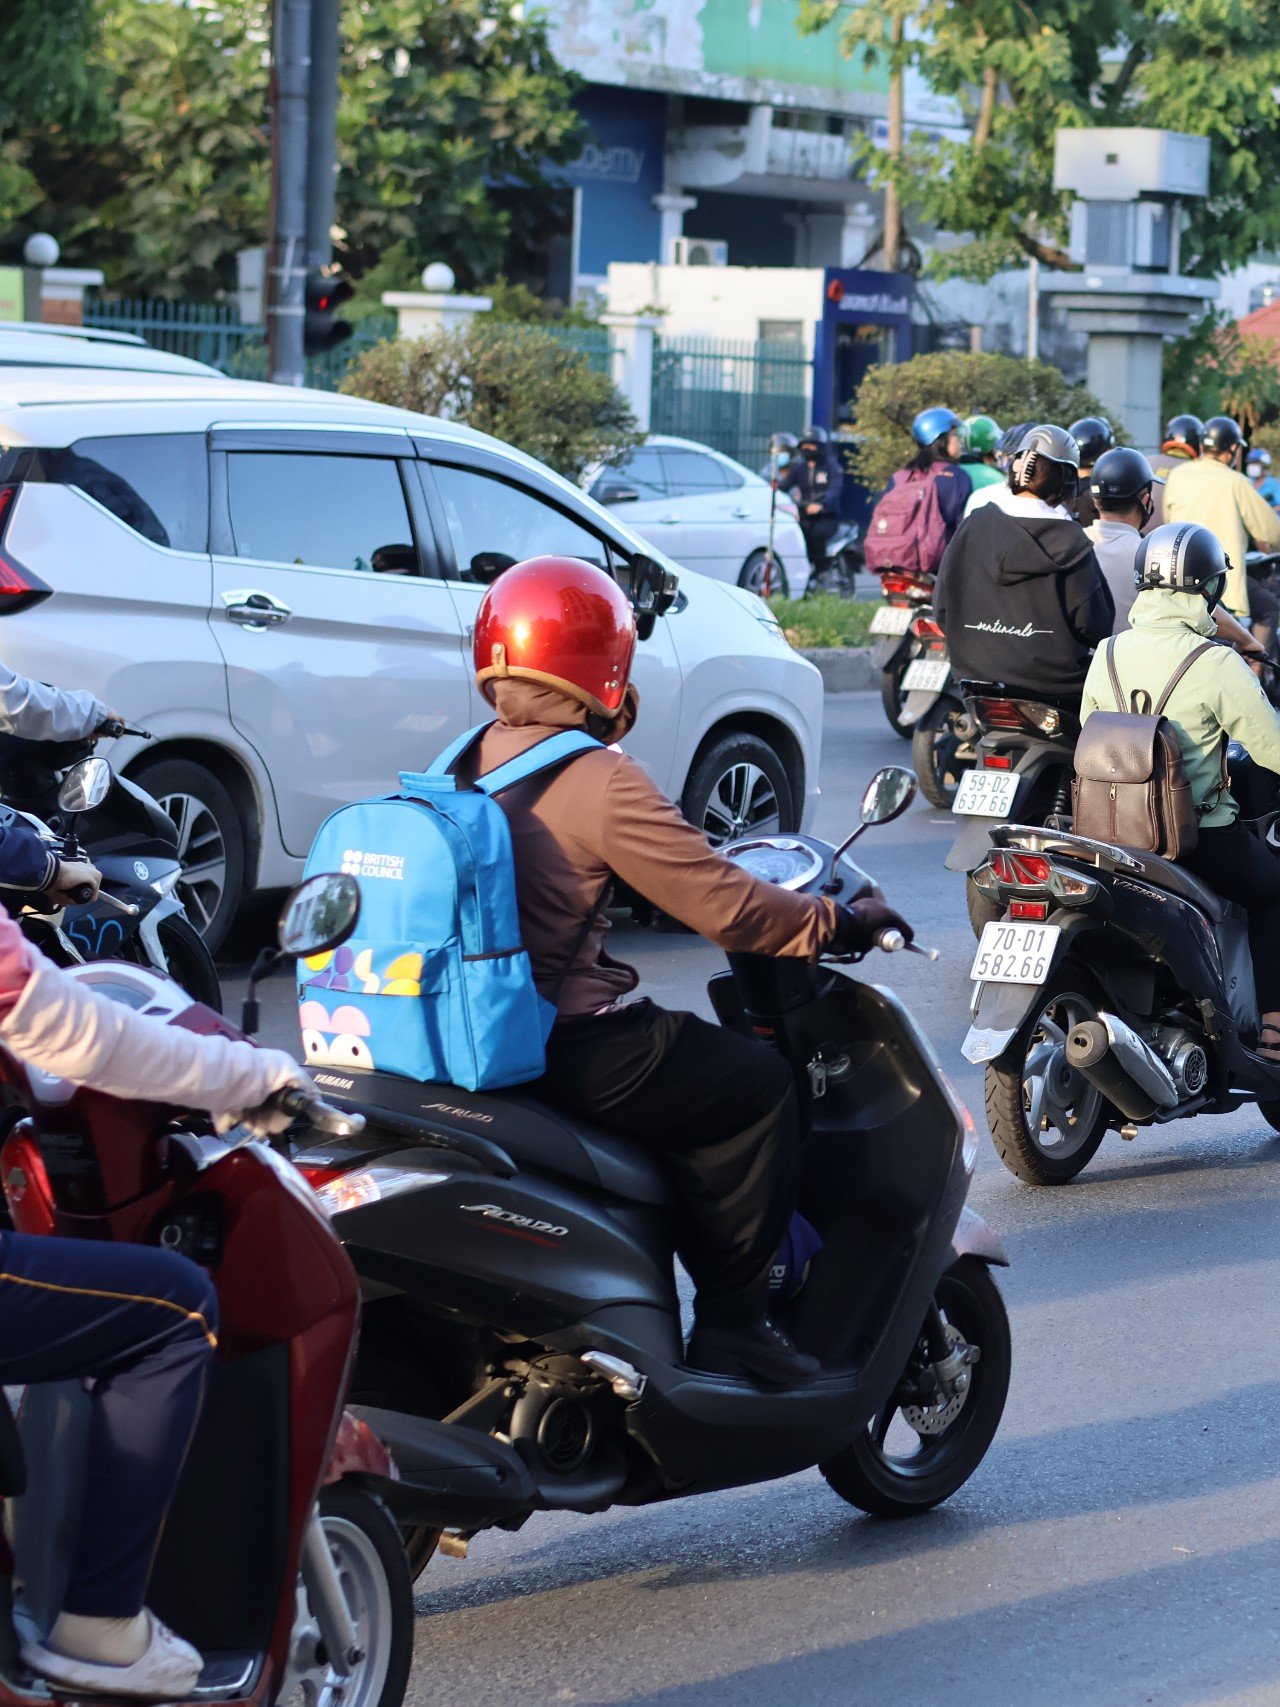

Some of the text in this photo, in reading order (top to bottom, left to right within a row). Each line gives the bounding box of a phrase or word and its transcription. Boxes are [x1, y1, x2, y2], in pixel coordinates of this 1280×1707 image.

[969, 774, 1010, 793] 59-D2
[958, 793, 1009, 813] 637.66
[363, 853, 405, 867] BRITISH
[362, 865, 405, 880] COUNCIL
[992, 927, 1046, 953] 70-D1
[977, 953, 1046, 979] 582.66
[313, 1073, 355, 1090] YAMAHA
